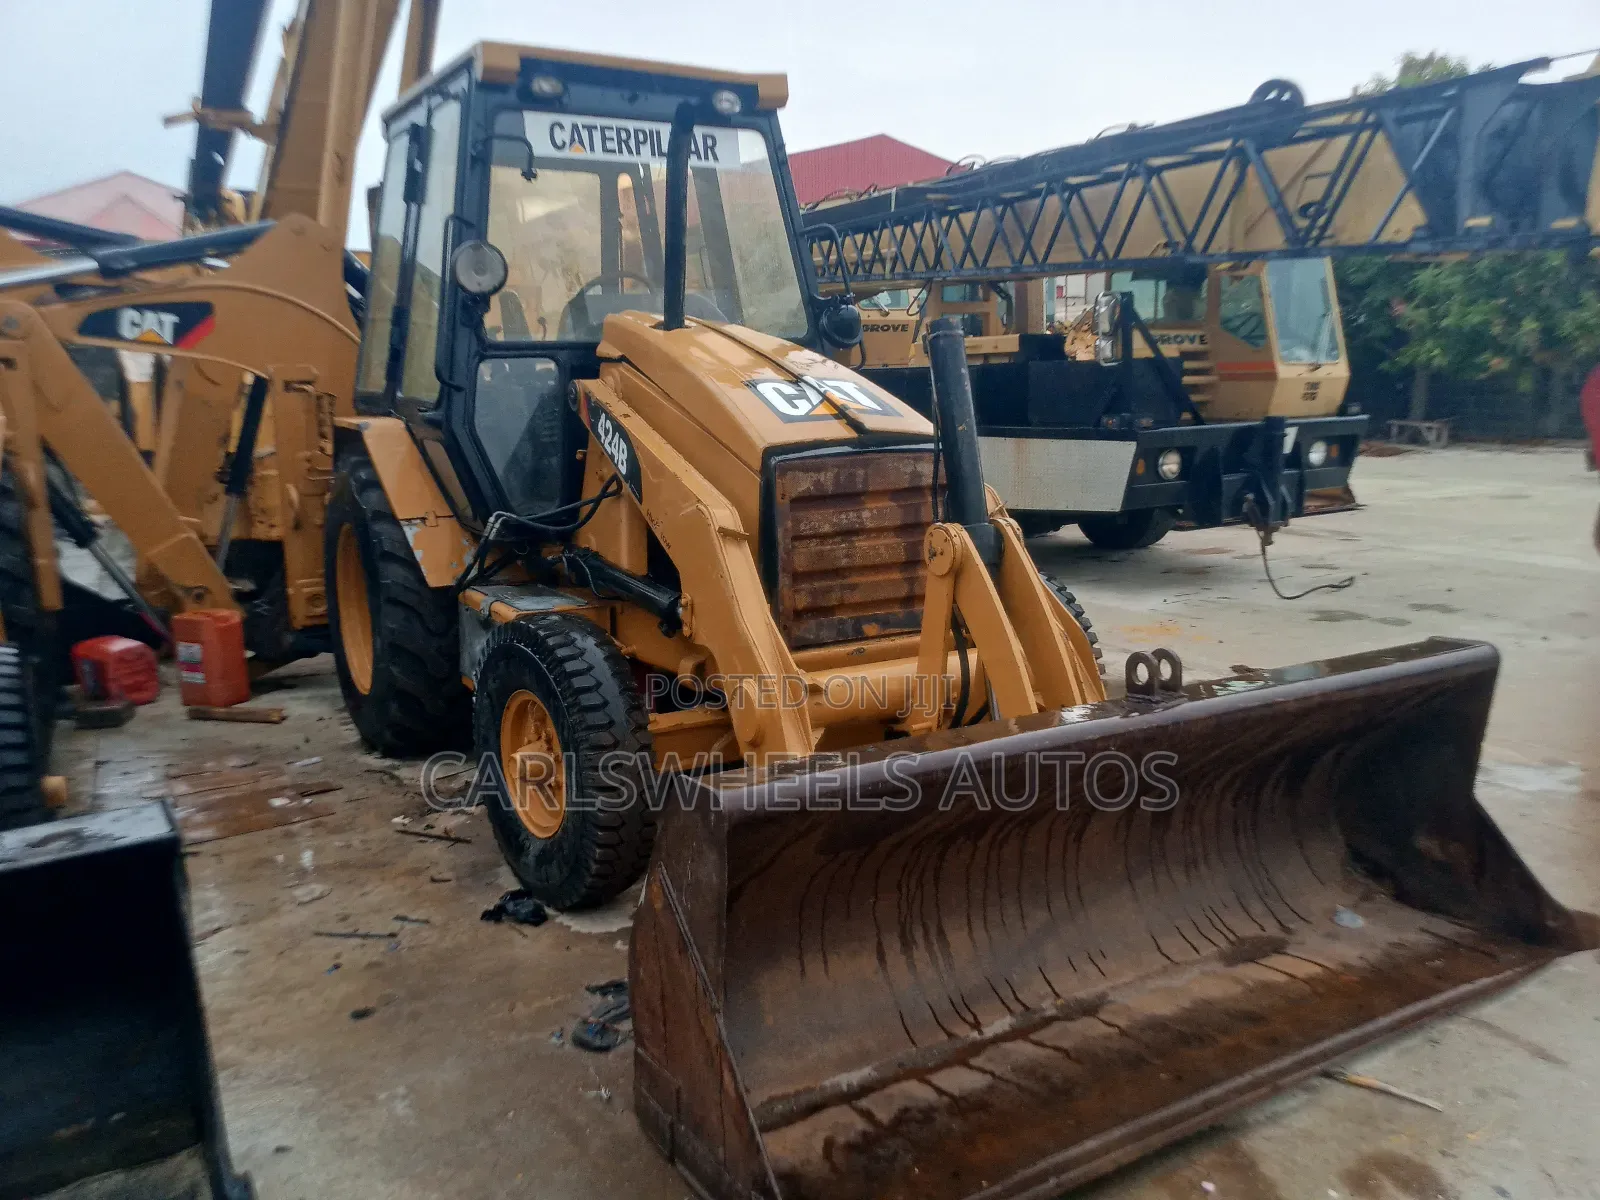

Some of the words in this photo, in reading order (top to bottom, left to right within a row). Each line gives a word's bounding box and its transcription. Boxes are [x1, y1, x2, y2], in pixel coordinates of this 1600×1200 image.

[549, 120, 720, 163] CATERPILAR
[118, 306, 180, 345] CAT
[862, 323, 909, 333] GROVE
[756, 375, 883, 416] CAT
[597, 412, 628, 475] 424B
